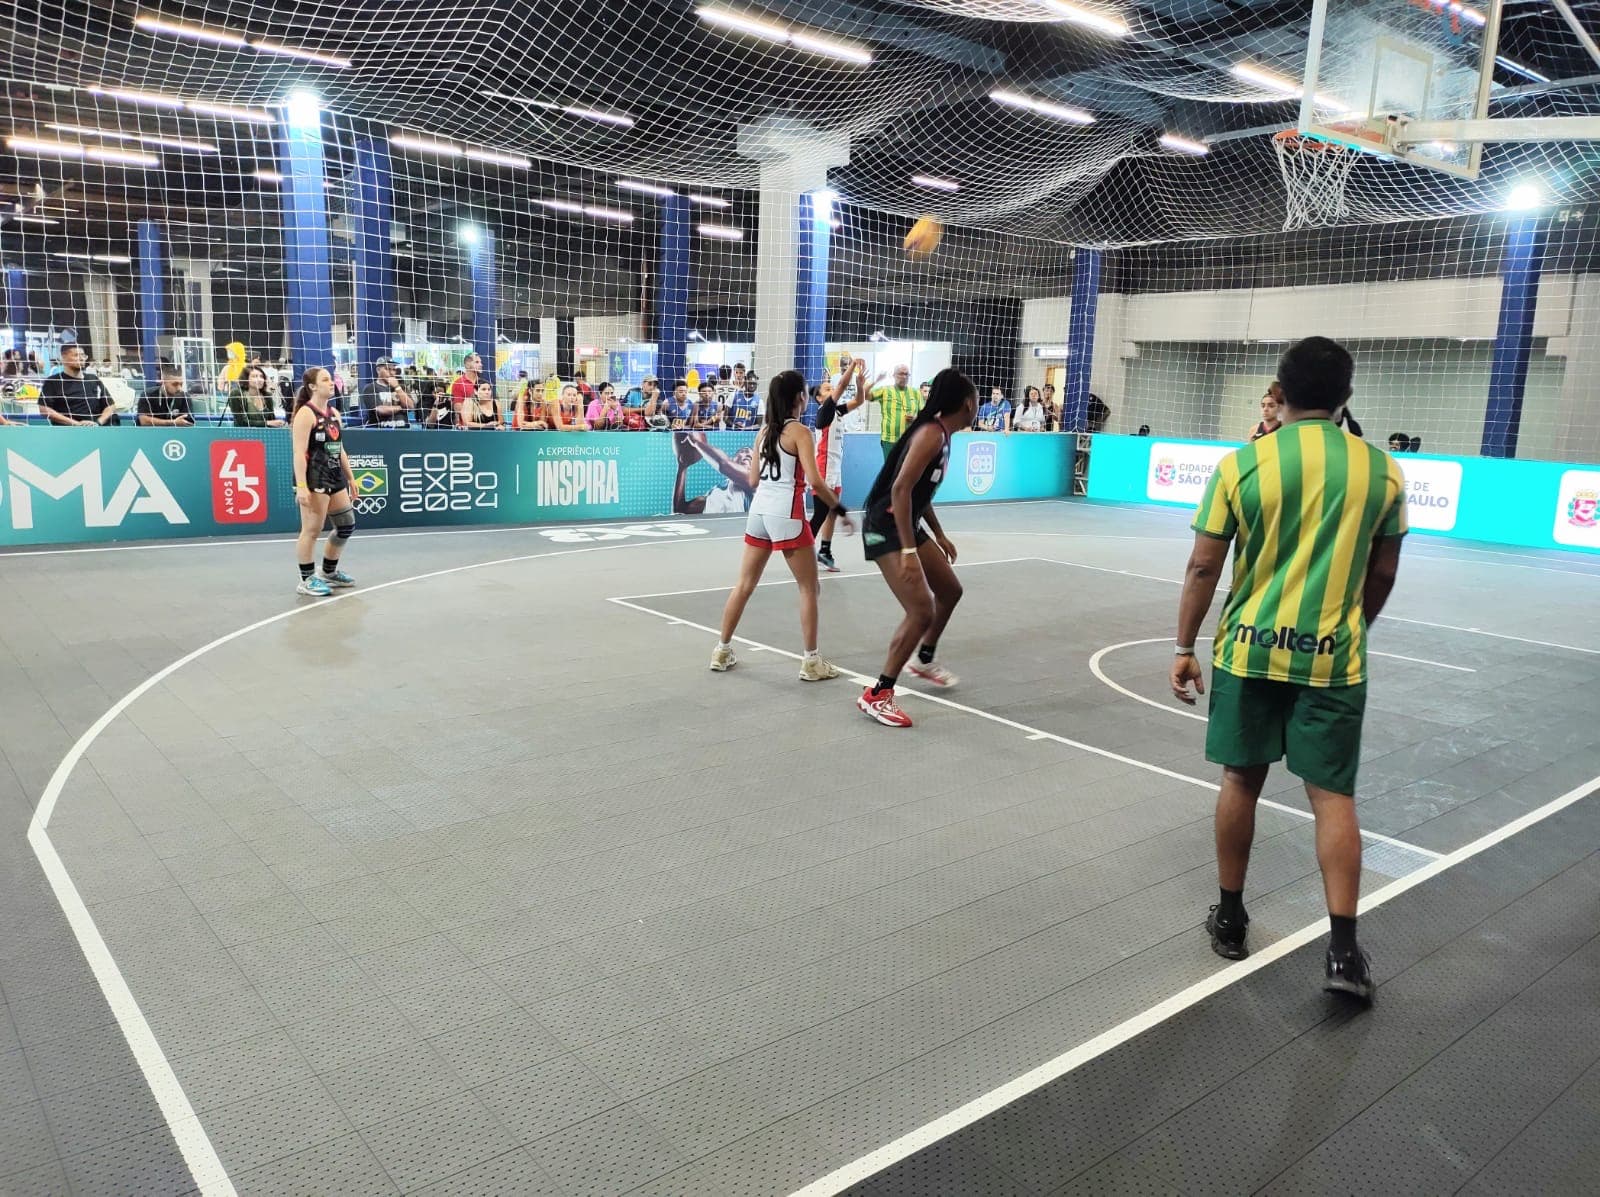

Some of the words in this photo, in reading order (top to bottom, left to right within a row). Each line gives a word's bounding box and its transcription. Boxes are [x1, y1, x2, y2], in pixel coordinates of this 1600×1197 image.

[537, 447, 545, 456] A
[546, 445, 601, 456] EXPERIÊNCIA
[602, 446, 621, 456] QUE
[399, 453, 474, 472] COB
[1179, 463, 1214, 473] CIDADE
[0, 447, 190, 529] MA
[400, 472, 498, 492] EXPO
[537, 459, 620, 506] INSPIRA
[1178, 472, 1202, 485] SÃO
[1413, 481, 1430, 492] DE
[224, 480, 235, 515] ANOS
[400, 491, 498, 513] 2024
[1407, 494, 1449, 508] AULO
[1234, 623, 1336, 655] molten
